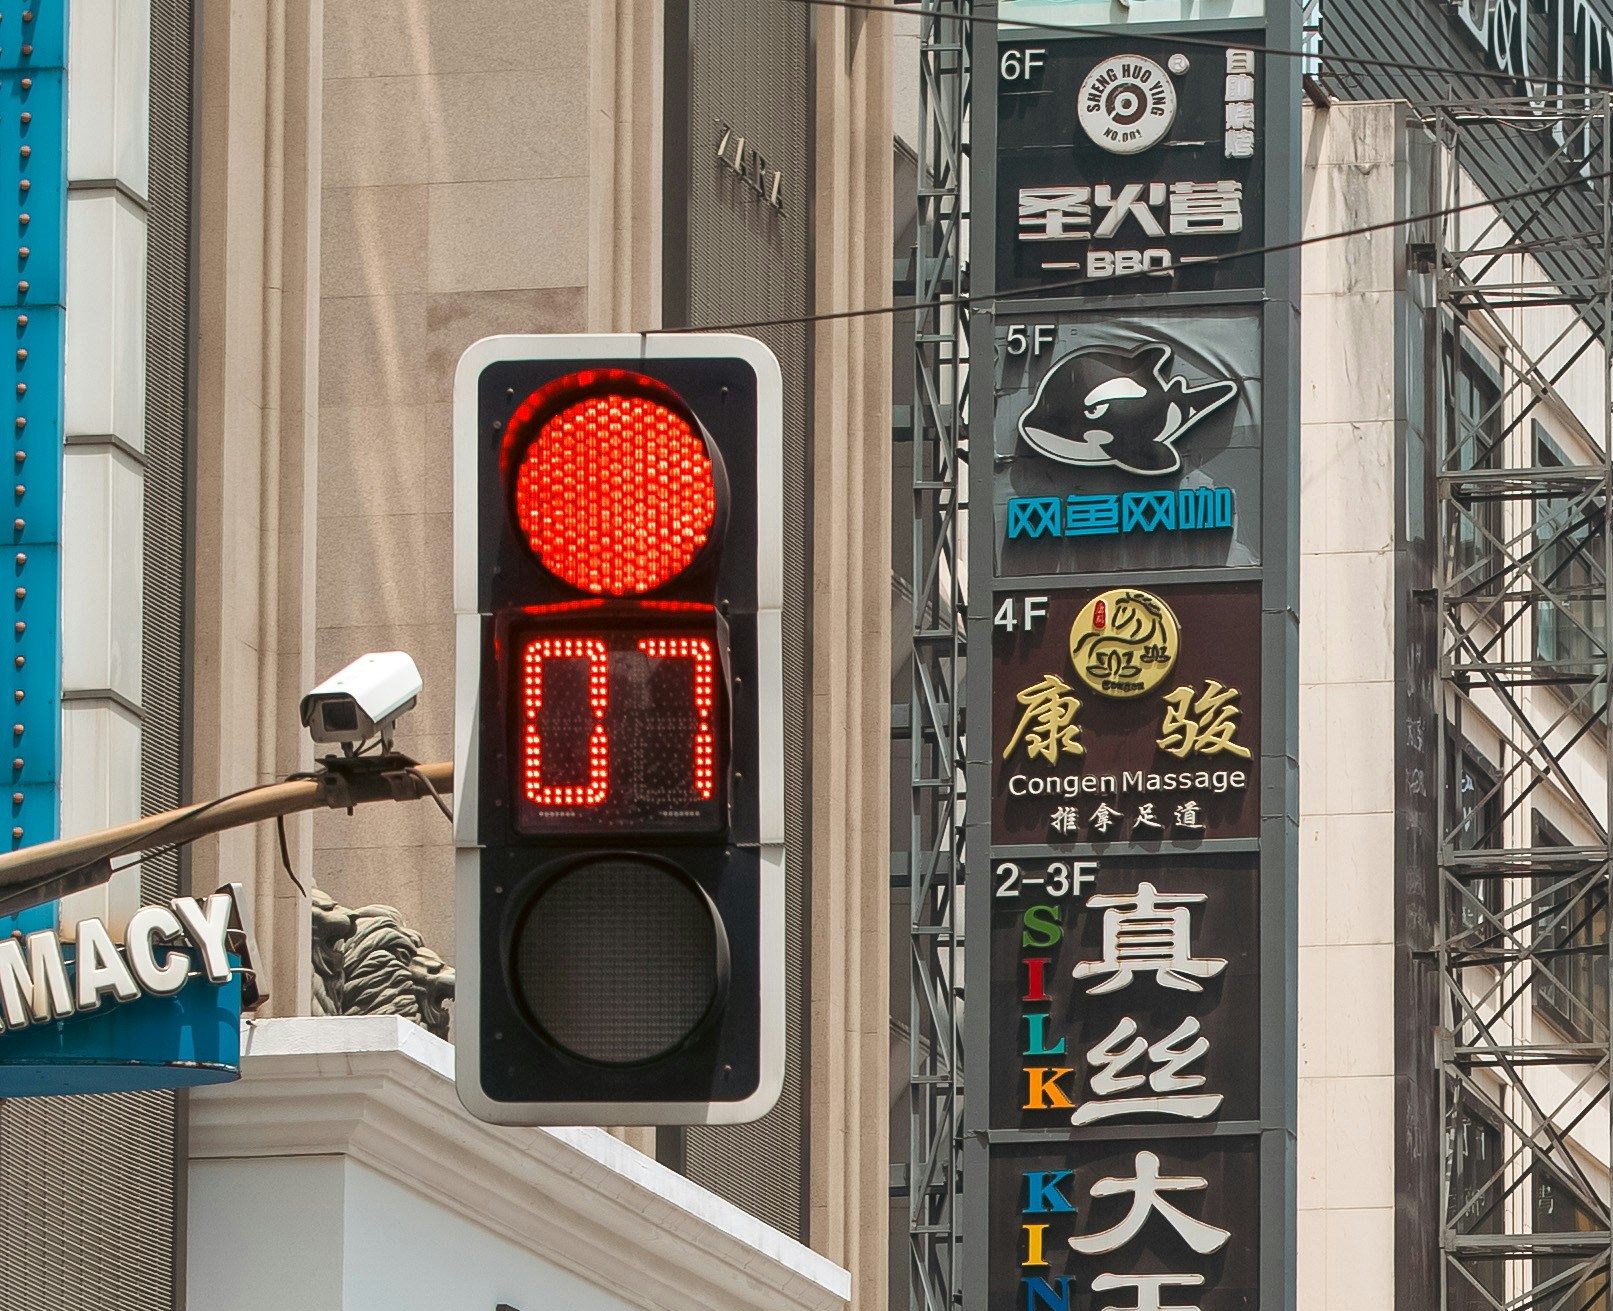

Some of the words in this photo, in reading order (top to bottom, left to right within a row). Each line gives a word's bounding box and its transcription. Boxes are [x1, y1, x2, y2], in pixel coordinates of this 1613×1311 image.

[1001, 49, 1046, 81] 6F
[1086, 67, 1118, 114] SHENG
[1121, 63, 1153, 84] HUO
[1148, 80, 1167, 117] YING
[1018, 180, 1243, 241] 圣火营
[1085, 248, 1175, 279] BBQ
[1006, 324, 1056, 356] 5F
[1007, 487, 1235, 539] 网鱼网咖
[993, 596, 1049, 632] 4F
[523, 636, 713, 806] 07
[1008, 774, 1116, 799] Congen
[1122, 770, 1246, 797] Massage
[1050, 800, 1208, 834] 推拿足道
[994, 861, 1098, 898] 2-3F
[0, 893, 233, 1036] MACY
[1022, 904, 1077, 1111] SILK
